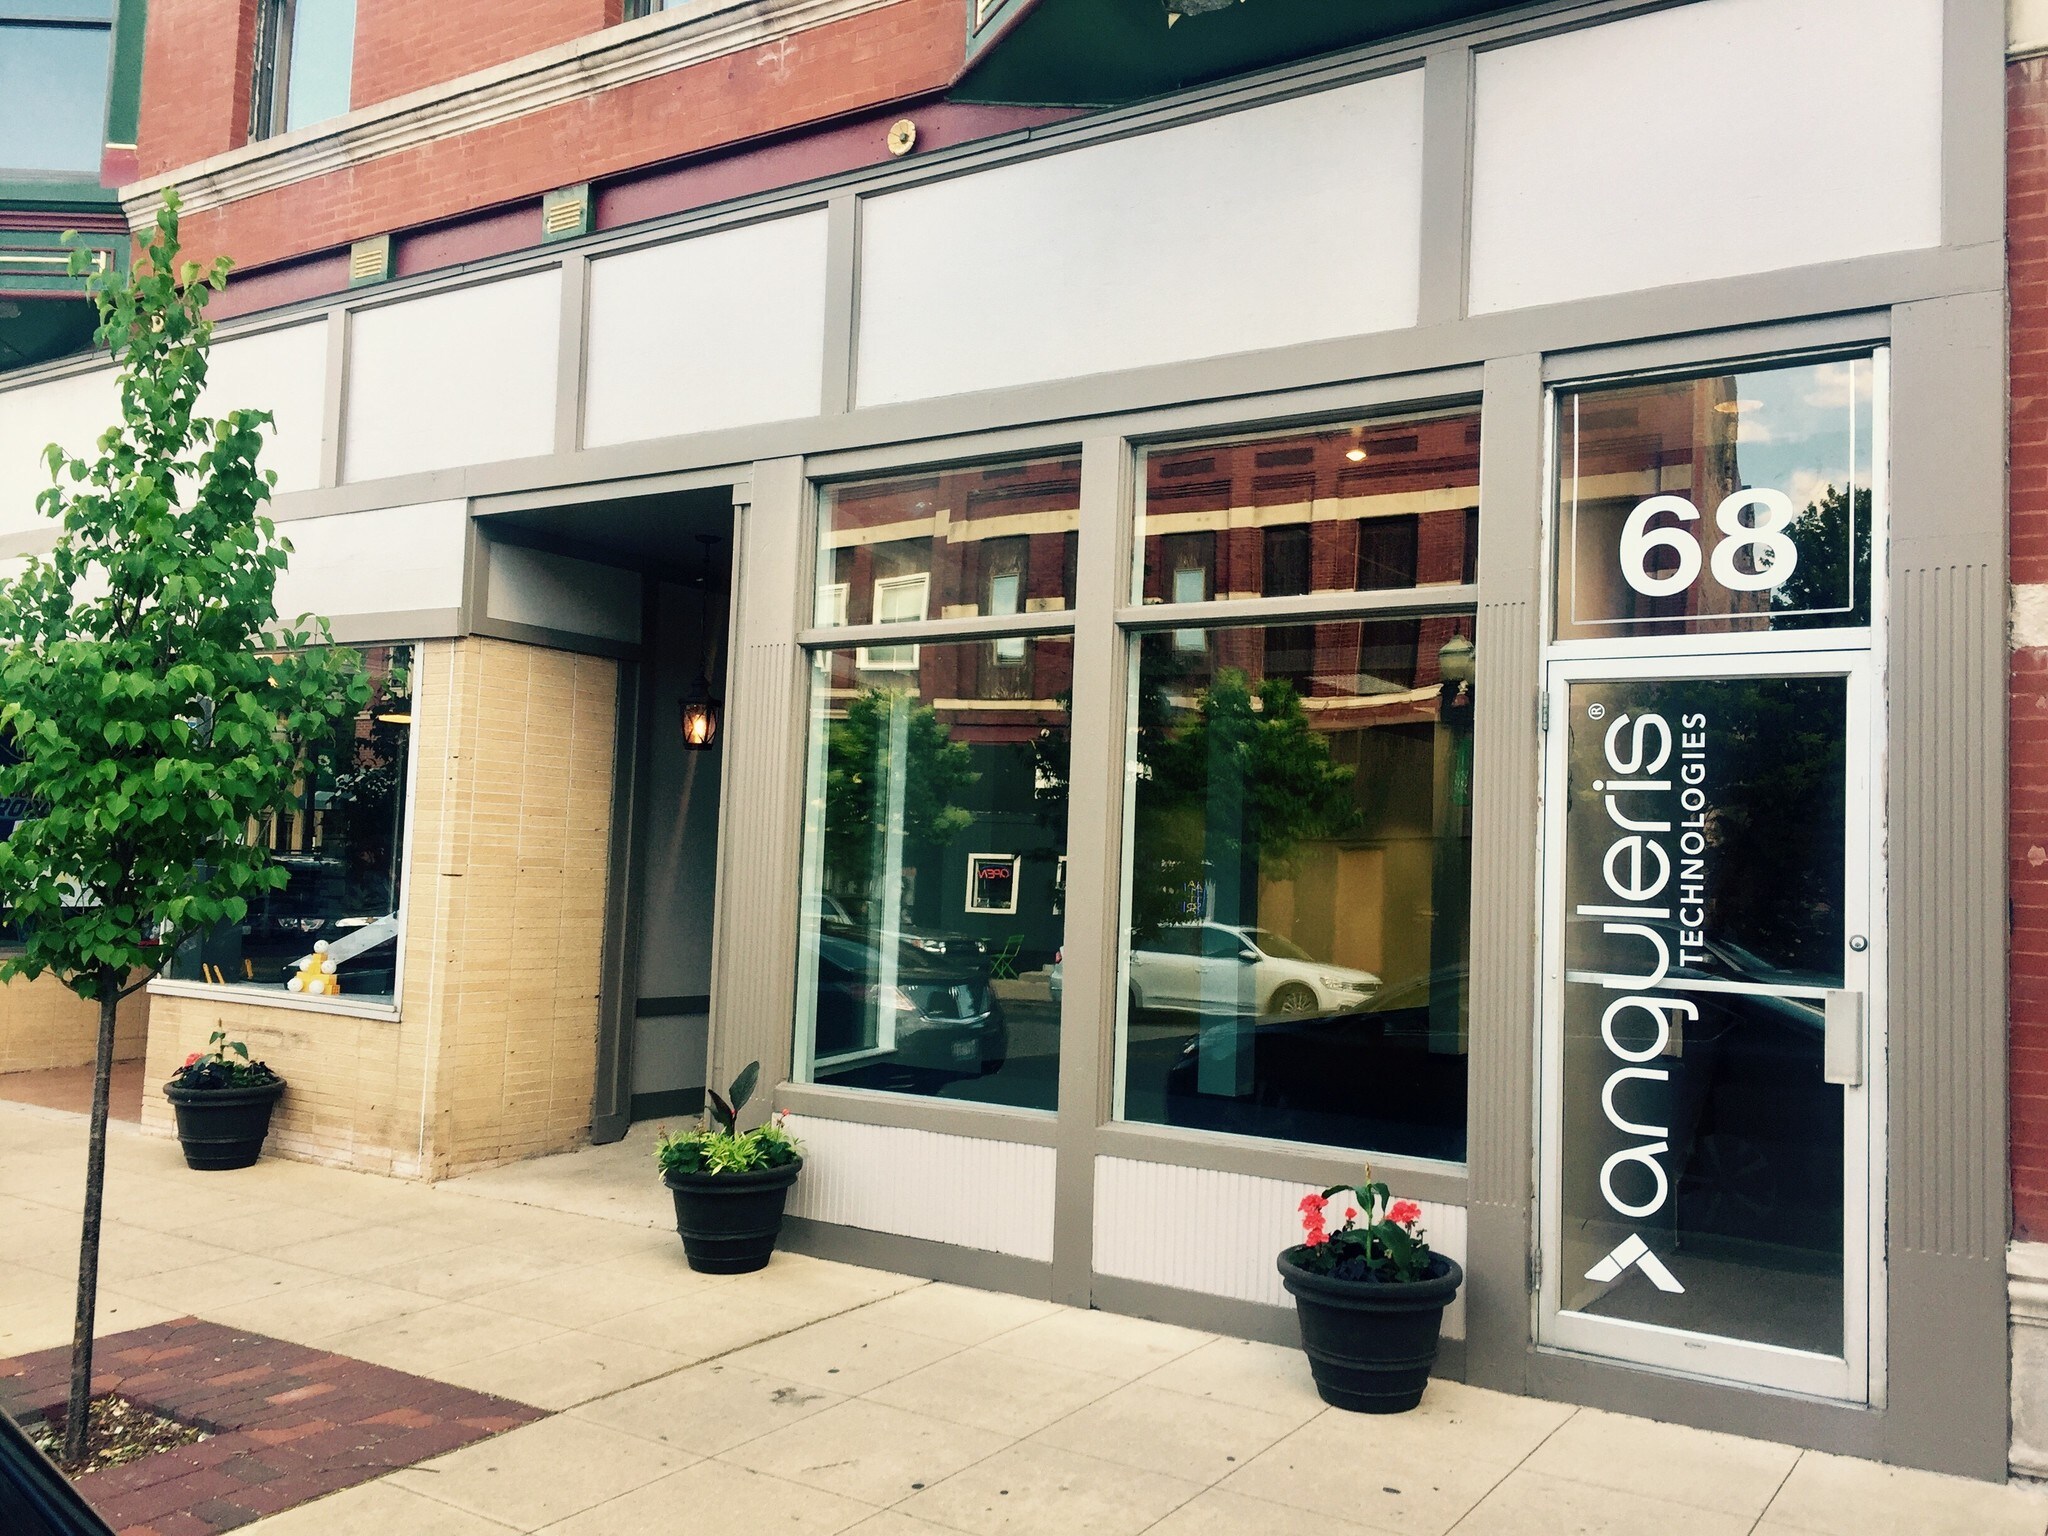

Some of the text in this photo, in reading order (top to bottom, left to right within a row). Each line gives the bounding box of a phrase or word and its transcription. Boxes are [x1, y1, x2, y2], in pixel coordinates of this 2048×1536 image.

[1619, 487, 1798, 597] 68
[1576, 712, 1699, 1218] anguleris
[1679, 712, 1706, 968] TECHNOLOGIES
